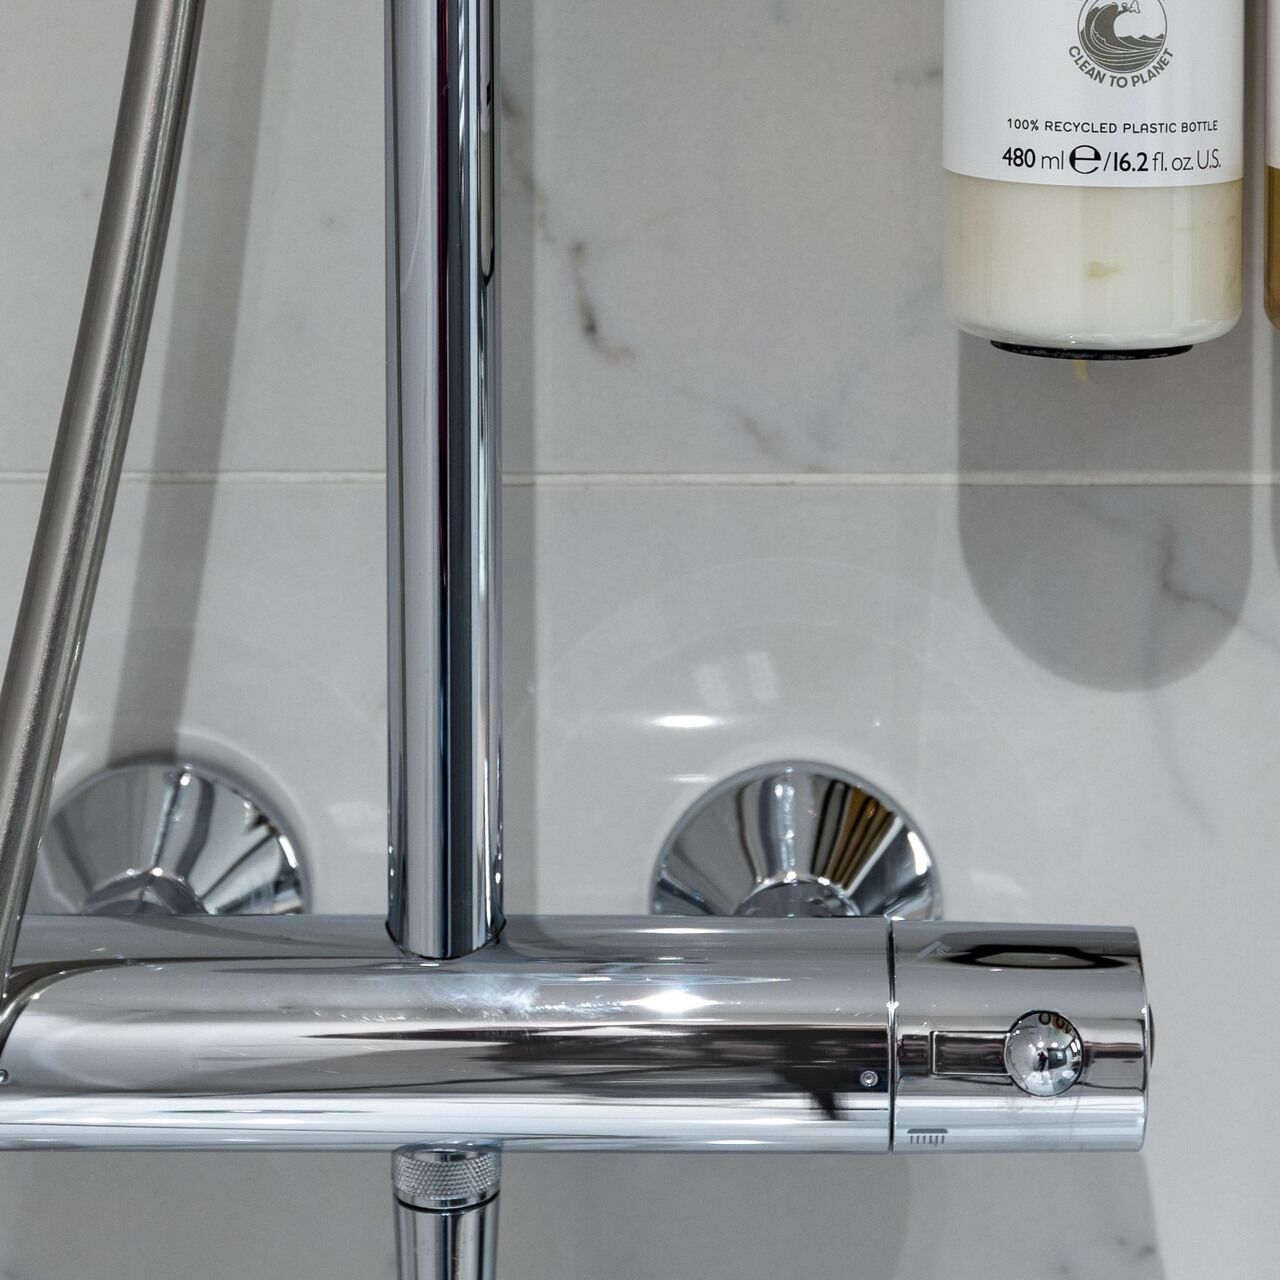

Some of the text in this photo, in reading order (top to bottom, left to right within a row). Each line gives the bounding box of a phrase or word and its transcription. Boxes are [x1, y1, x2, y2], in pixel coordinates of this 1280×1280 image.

[1069, 46, 1174, 89] CLEAN TO PLANET
[1007, 118, 1219, 134] 100% RECYCLED PLASTIC BOTTLE
[1001, 146, 1036, 169] 480
